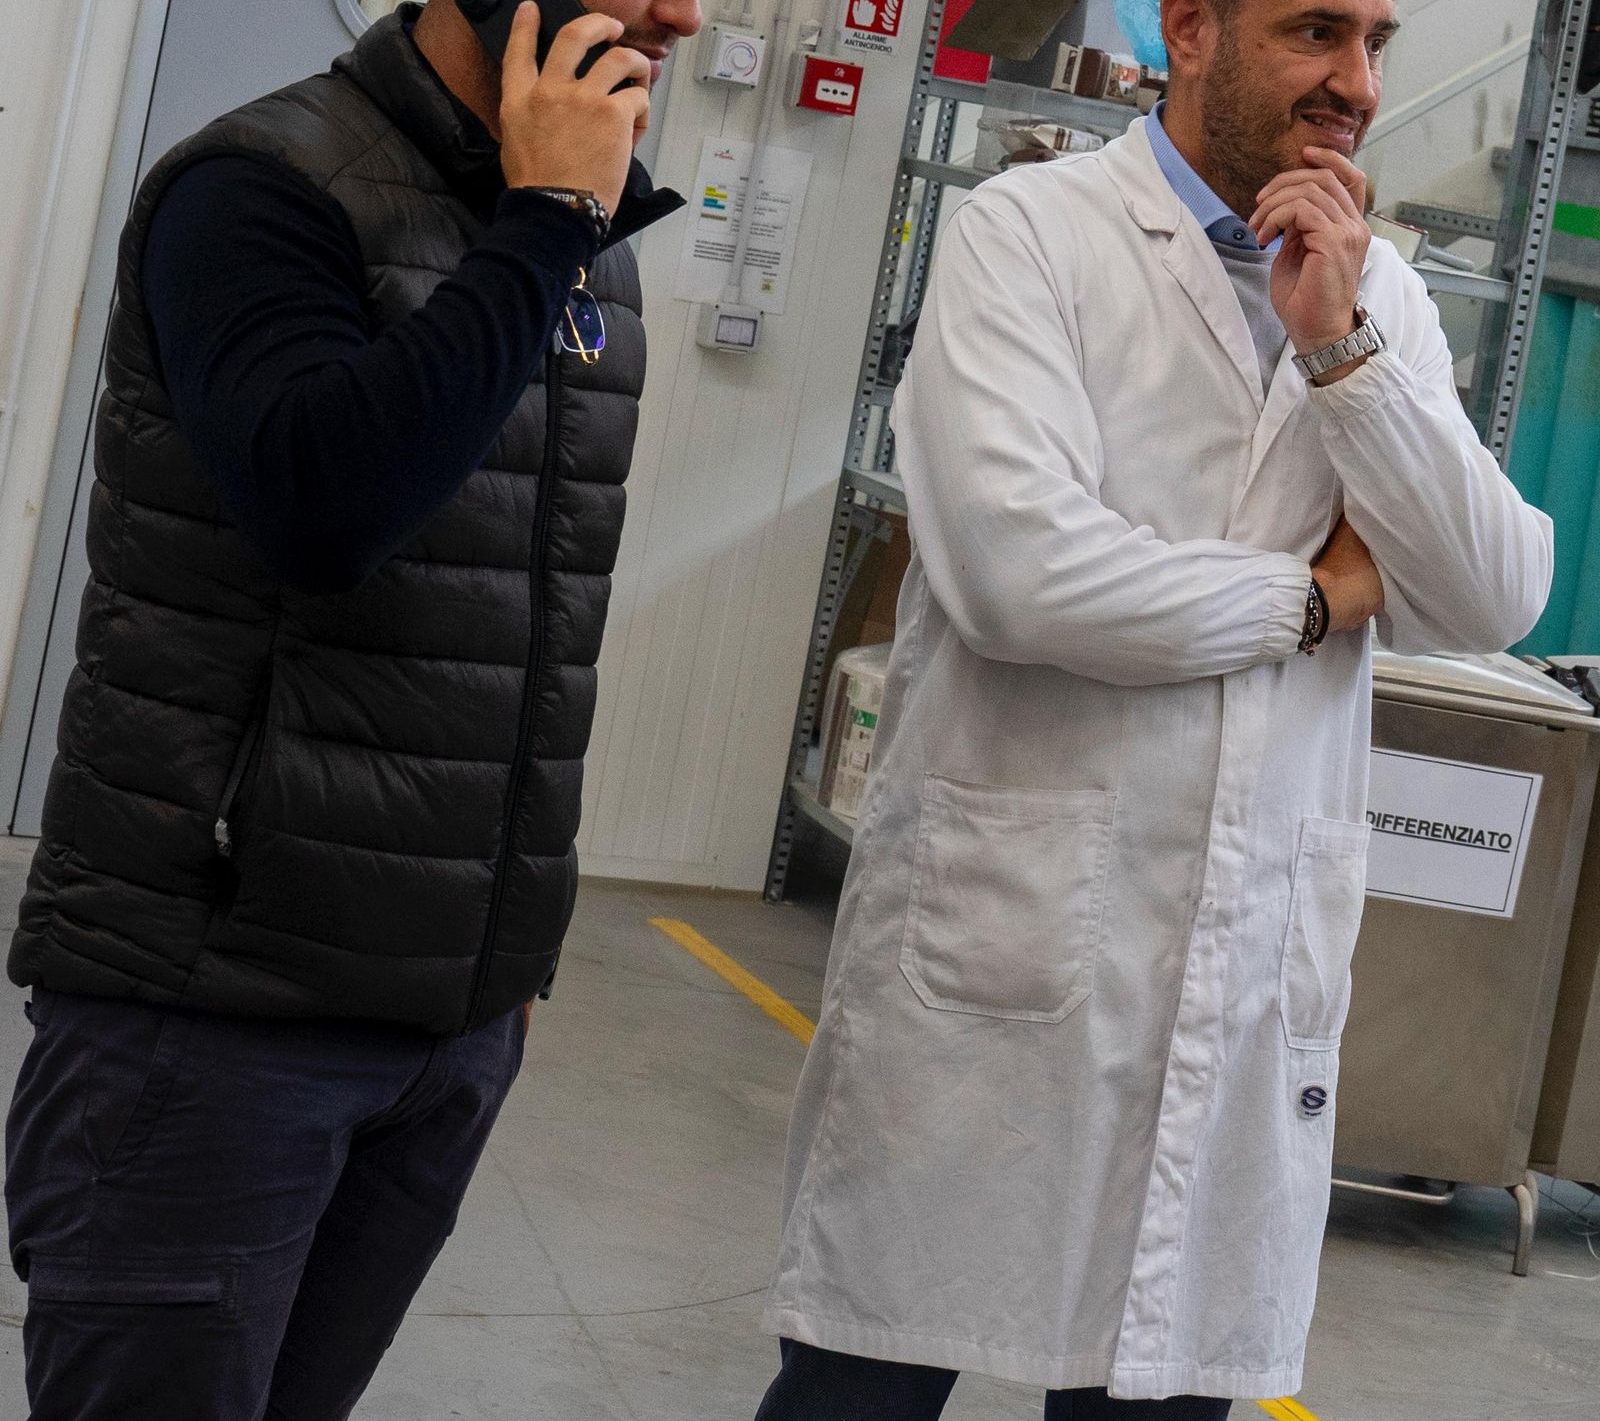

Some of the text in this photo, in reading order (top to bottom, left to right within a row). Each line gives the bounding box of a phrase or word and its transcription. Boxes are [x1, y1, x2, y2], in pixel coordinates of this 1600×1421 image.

[852, 31, 887, 44] ALLARME
[844, 38, 893, 53] ANTINCENDIO
[1366, 810, 1512, 849] DIFFERENZIATO
